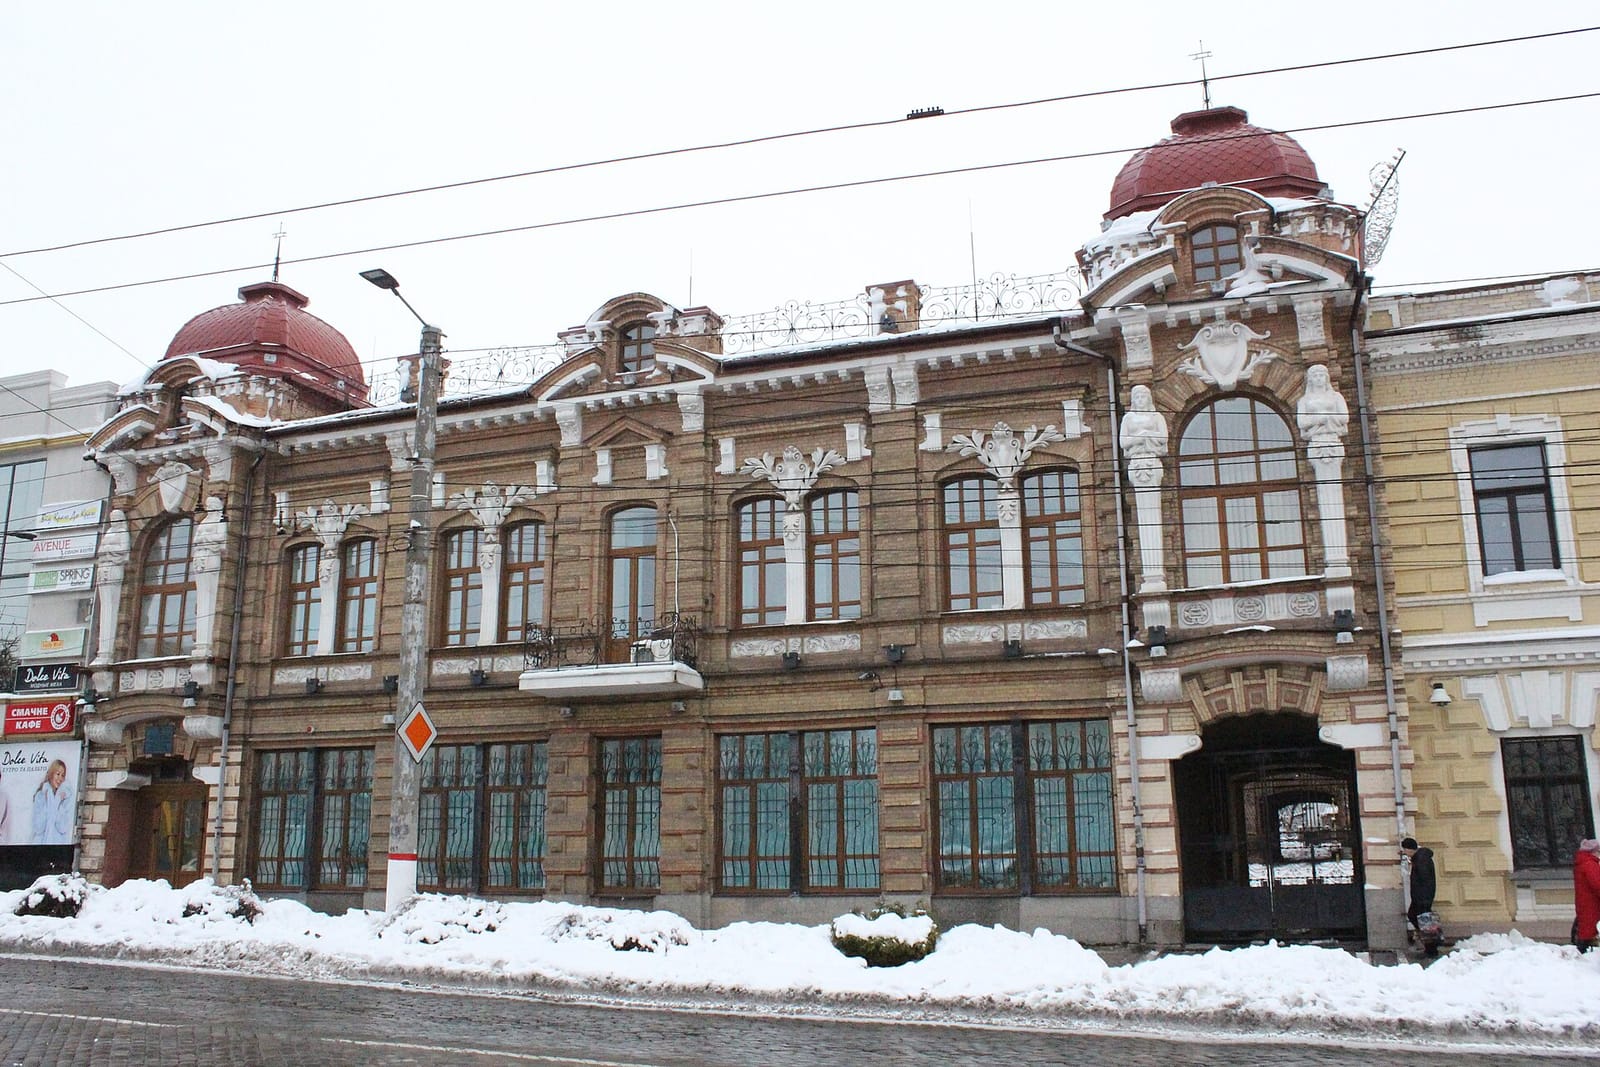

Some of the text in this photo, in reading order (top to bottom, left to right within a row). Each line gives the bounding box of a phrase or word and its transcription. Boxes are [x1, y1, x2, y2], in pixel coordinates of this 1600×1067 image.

[34, 540, 71, 552] AVENUE
[60, 568, 90, 581] SPRING
[25, 667, 71, 682] Dolce Vita
[11, 708, 48, 717] СМАЧНЕ
[16, 720, 41, 729] КАФЕ
[2, 750, 48, 765] Dolce Vita
